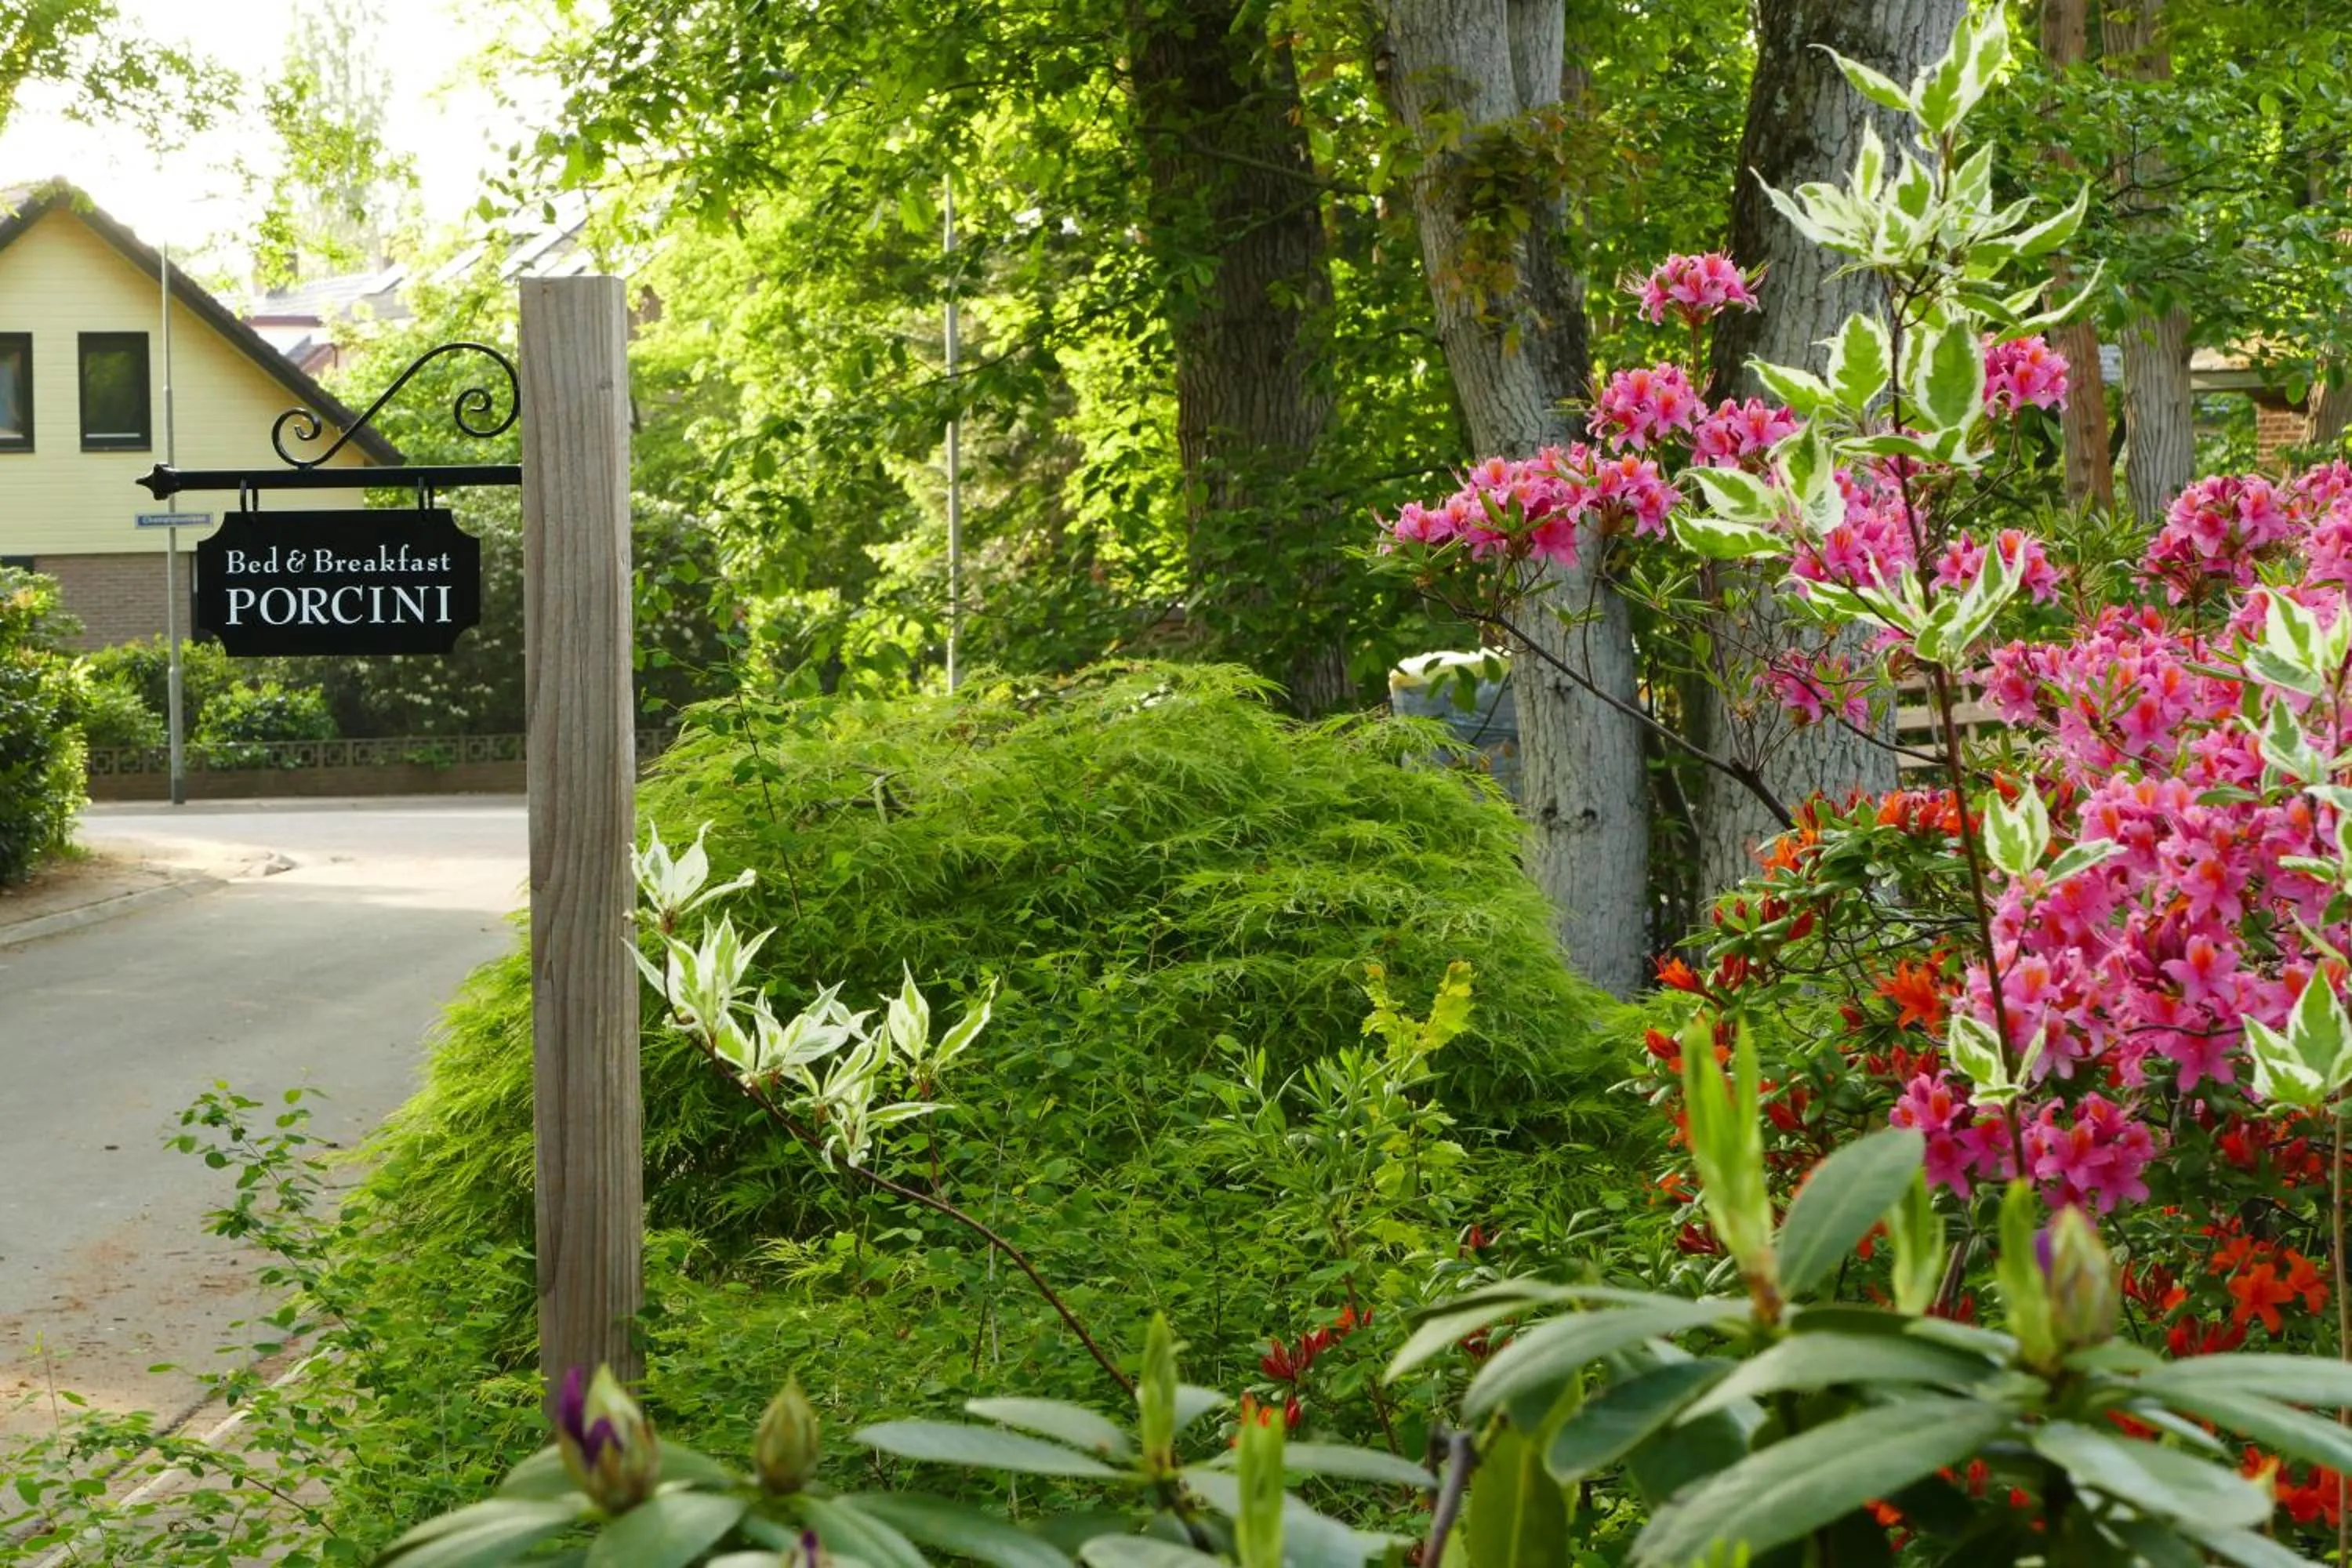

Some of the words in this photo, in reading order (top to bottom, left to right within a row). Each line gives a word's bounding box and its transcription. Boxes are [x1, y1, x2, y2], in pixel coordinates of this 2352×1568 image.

[225, 546, 279, 574] Bed
[286, 550, 307, 573] &
[314, 544, 452, 573] Breakfast
[225, 584, 452, 626] PORCINI
